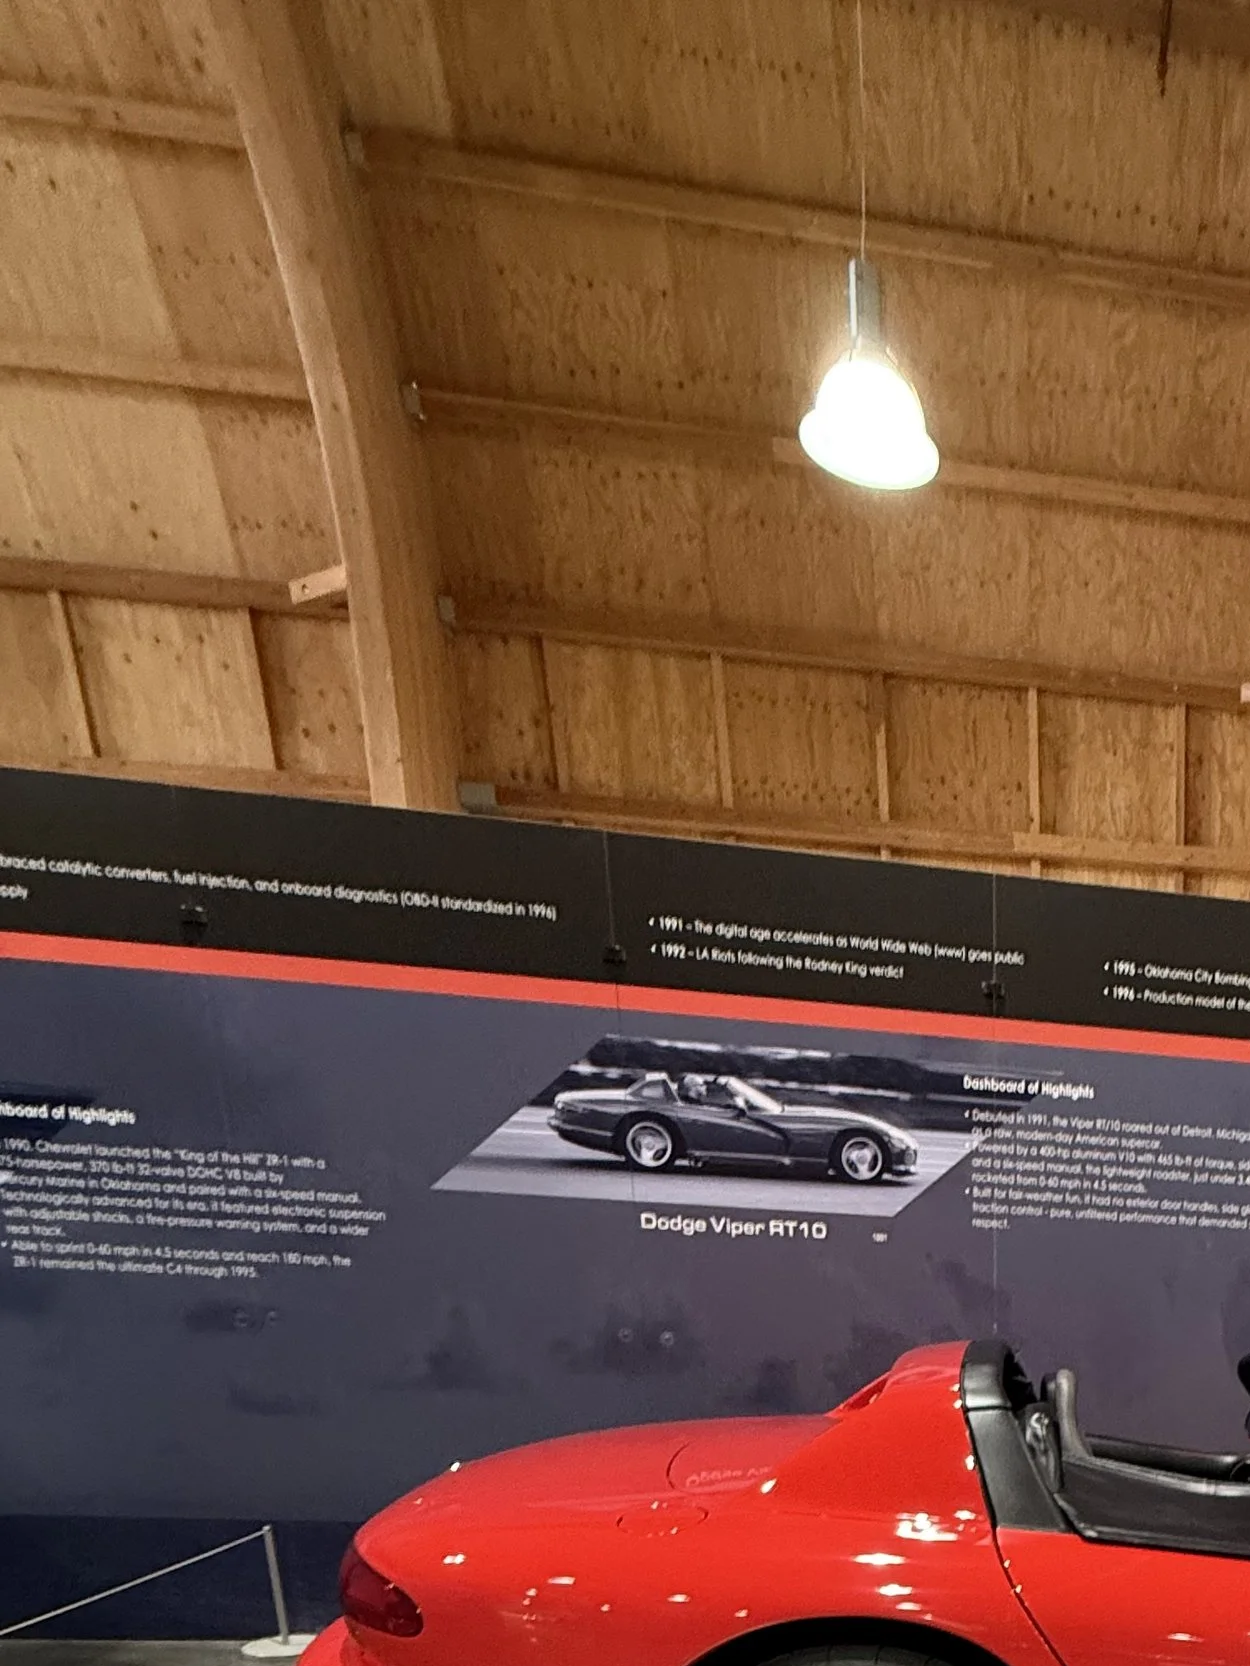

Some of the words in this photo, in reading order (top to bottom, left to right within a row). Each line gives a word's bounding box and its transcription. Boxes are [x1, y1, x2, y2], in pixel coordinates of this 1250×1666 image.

[659, 916, 682, 930] 1991
[694, 919, 712, 934] The
[715, 923, 747, 938] digital
[749, 928, 770, 941] age
[773, 930, 833, 946] accelerates
[836, 936, 847, 947] as
[850, 936, 878, 950] World
[881, 939, 906, 953] Wide
[908, 942, 931, 956] Web
[968, 949, 992, 962] goes
[994, 951, 1024, 964] public
[661, 943, 685, 958] 1992
[696, 947, 708, 960] LA
[711, 948, 735, 963] Riots
[737, 950, 783, 969] following
[785, 955, 802, 969] the
[804, 957, 842, 973] Rodney
[844, 961, 867, 977] King
[869, 965, 903, 978] verdict
[963, 1074, 1025, 1093] Dashboard
[1028, 1079, 1038, 1094] of
[1041, 1082, 1094, 1100] Highlights
[640, 1212, 706, 1235] Dodge
[710, 1216, 764, 1237] Viper
[769, 1220, 826, 1238] RT10
